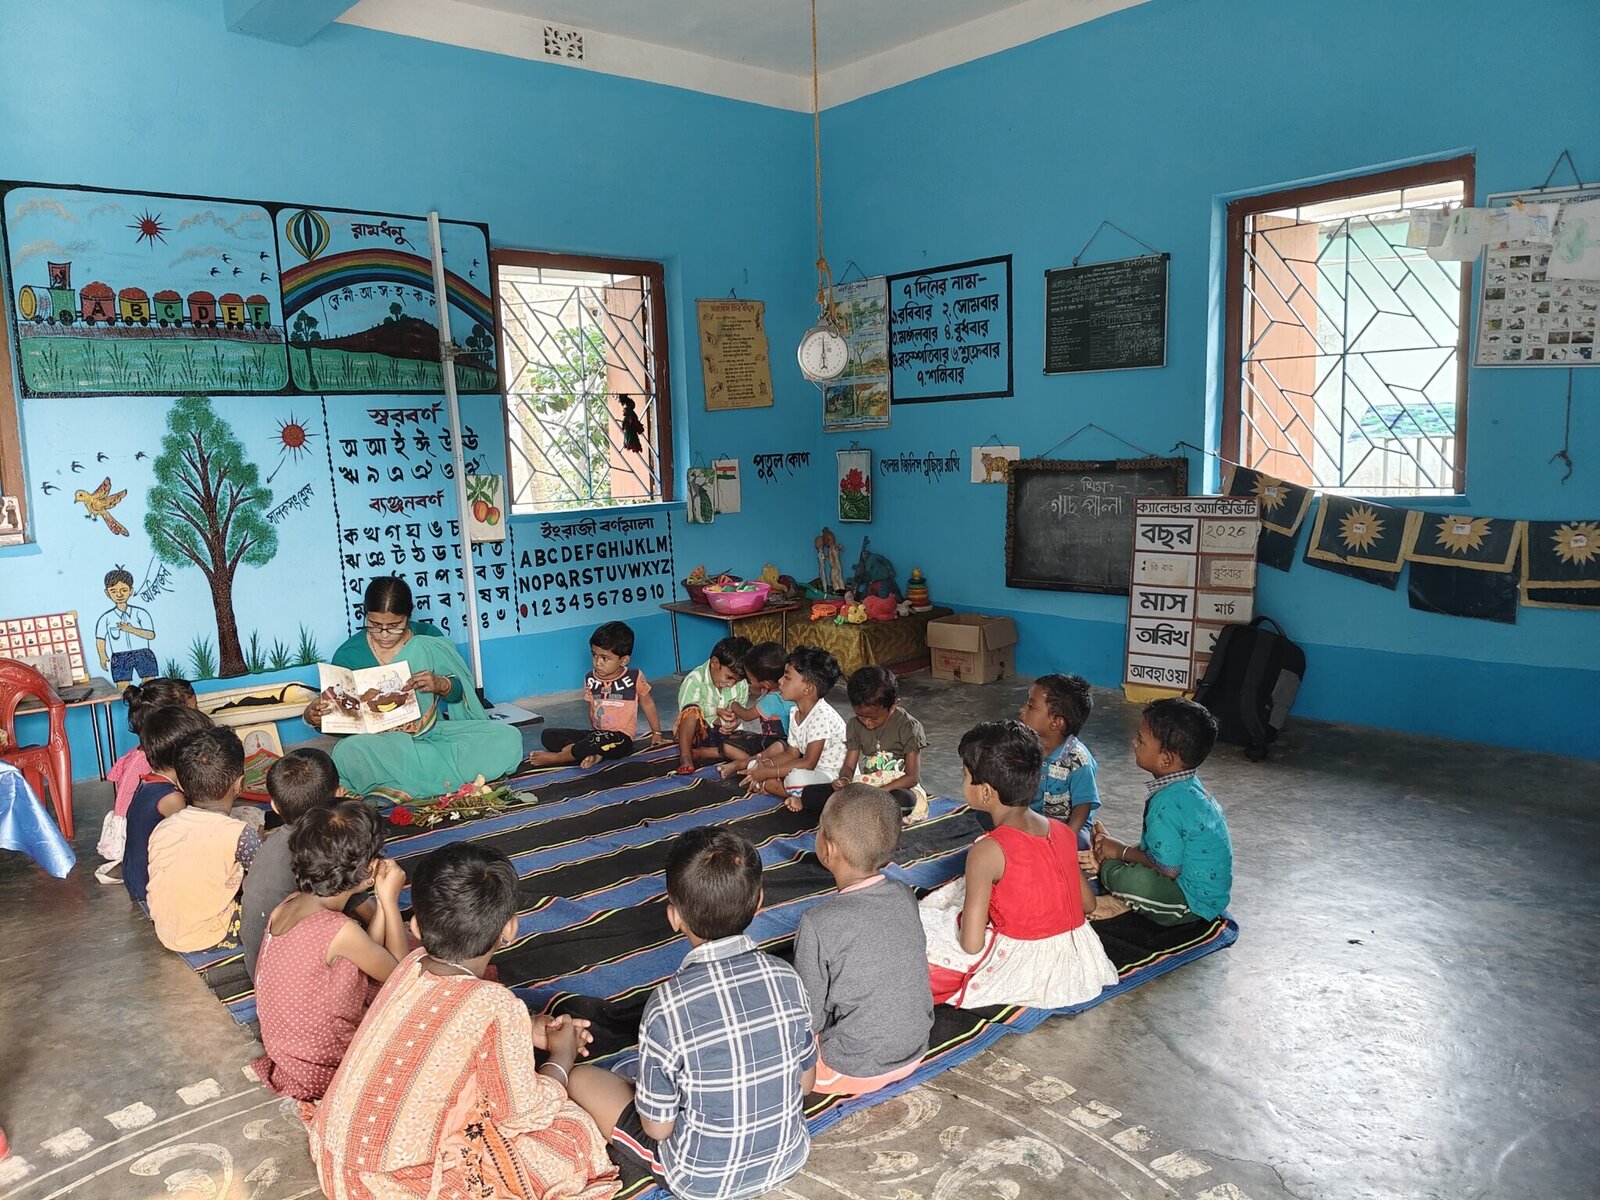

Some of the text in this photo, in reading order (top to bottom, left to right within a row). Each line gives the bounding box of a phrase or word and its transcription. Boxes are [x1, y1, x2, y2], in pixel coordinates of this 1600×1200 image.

[351, 221, 416, 250] রামধনু
[904, 284, 911, 299] ৭
[914, 276, 948, 300] দিনের
[91, 302, 263, 321] A B C D E F
[367, 400, 444, 427] স্বরবর্ণ
[339, 439, 358, 457] অ
[363, 438, 387, 456] আ
[390, 429, 410, 460] ই
[413, 428, 437, 457] ঈ
[338, 466, 359, 485] ঋ
[387, 466, 404, 482] এ
[411, 459, 432, 480] ঐ
[440, 463, 454, 480] ও
[753, 453, 784, 484] পুতুল
[369, 488, 446, 518] ব্যঞ্জনবর্ণ
[1137, 502, 1192, 514] ক্যালেন্ডার
[344, 528, 359, 546] ক
[363, 526, 381, 543] খ
[385, 525, 400, 541] গ
[405, 523, 421, 539] ঘ
[428, 521, 443, 539] ঙ
[540, 517, 654, 542] ইংরাজী বর্ণমালা
[1140, 524, 1194, 550] বছর
[345, 553, 361, 569] ঝ
[365, 551, 386, 568] ঞ
[391, 543, 406, 565] ট
[411, 540, 425, 562] ঠ
[432, 545, 447, 561] ড
[491, 541, 503, 557] ত
[349, 577, 365, 595] থ
[414, 571, 429, 587] ন
[435, 568, 450, 585] প
[474, 566, 486, 580] ব
[491, 563, 507, 579] ভ
[416, 595, 431, 610] ল
[438, 593, 451, 608] ব
[478, 588, 491, 603] ষ
[496, 586, 510, 601] স
[1139, 592, 1188, 613] মাস
[1213, 600, 1235, 615] মার্চ
[1135, 623, 1189, 647] তারিখ
[587, 675, 634, 692] STYLE
[1130, 664, 1188, 684] আবহাওয়া
